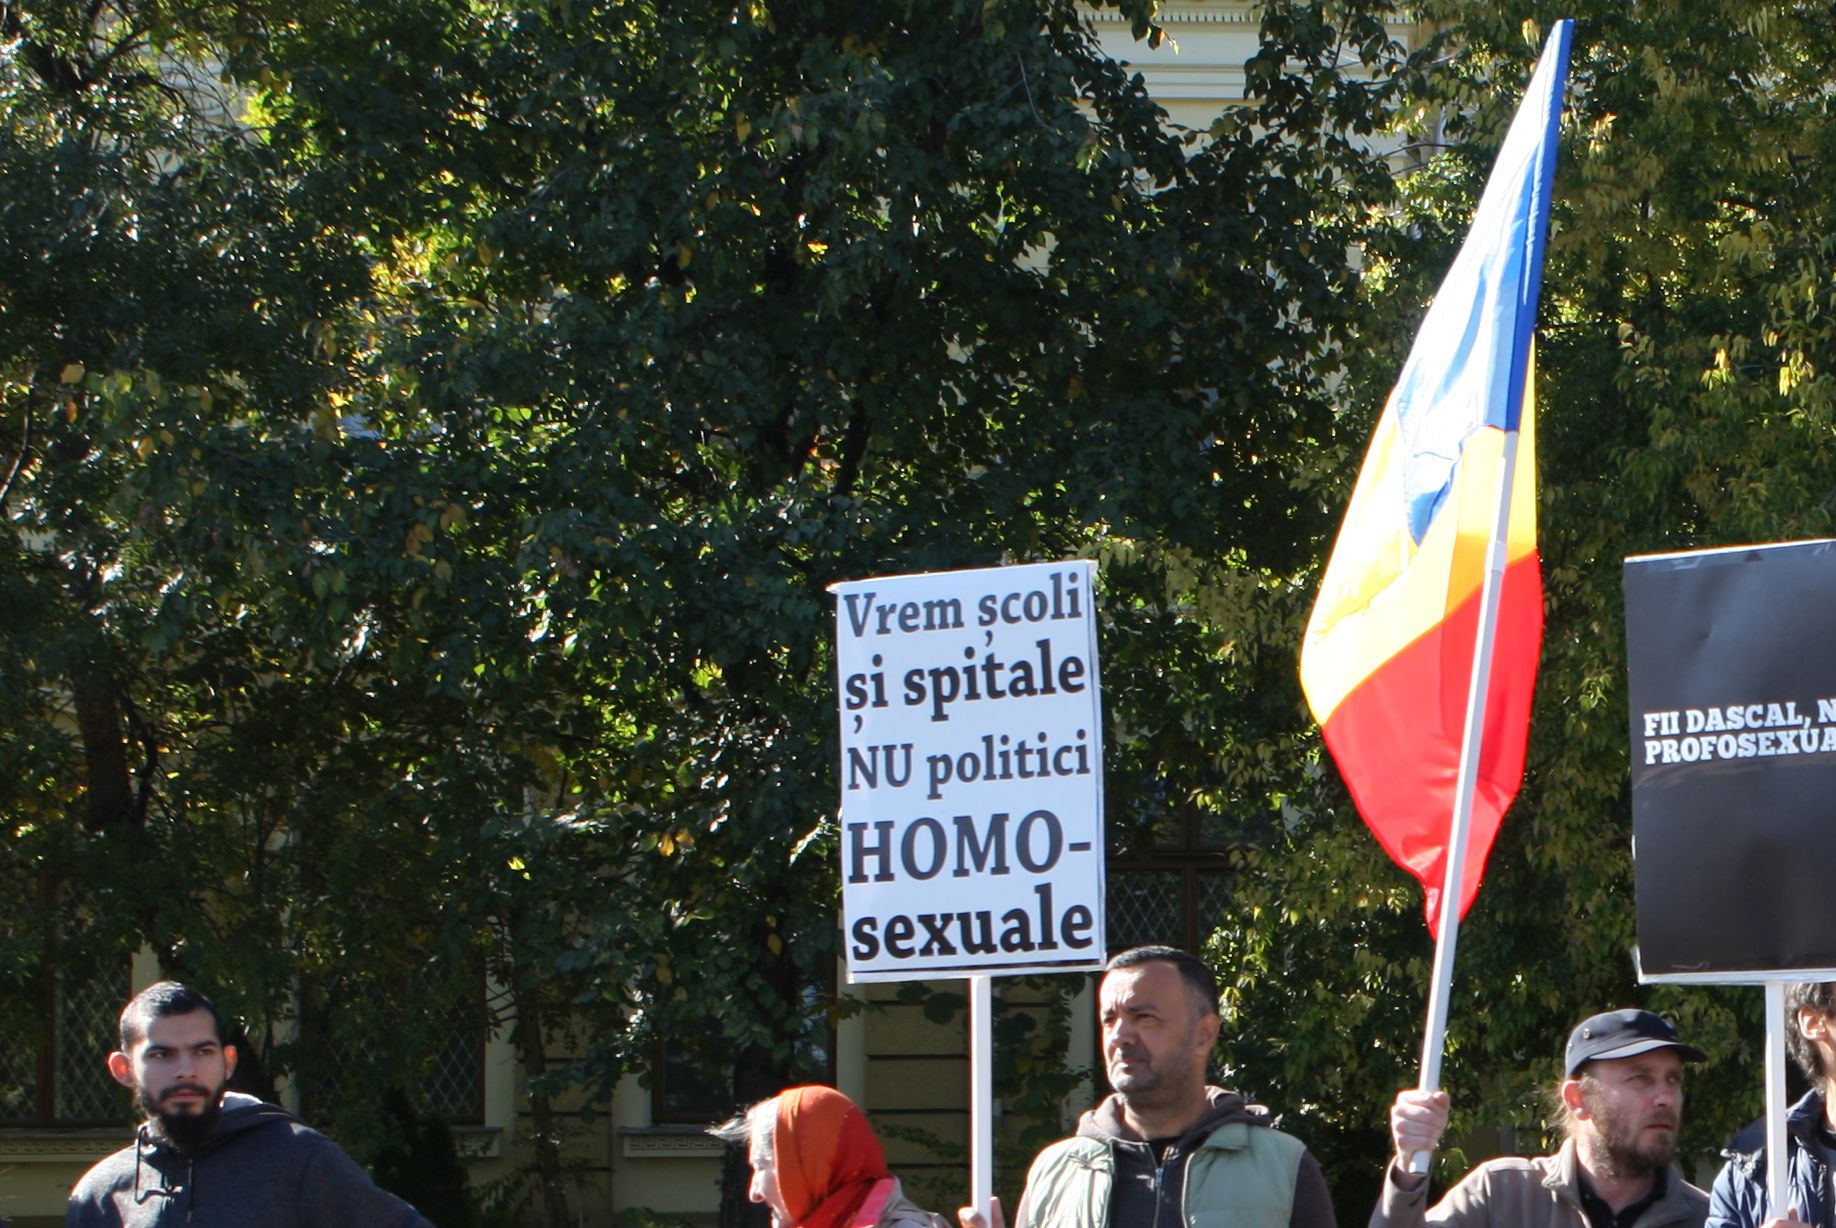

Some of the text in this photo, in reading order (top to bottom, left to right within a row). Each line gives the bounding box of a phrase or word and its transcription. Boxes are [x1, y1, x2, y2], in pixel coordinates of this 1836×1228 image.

[843, 572, 1082, 647] Vrem școli
[846, 639, 1085, 733] și spitale
[1644, 711, 1680, 737] FII
[1686, 701, 1812, 734] DASCAL,
[847, 729, 1090, 799] NU politici
[848, 809, 1091, 883] HOMO-
[852, 882, 1093, 960] sexuale
